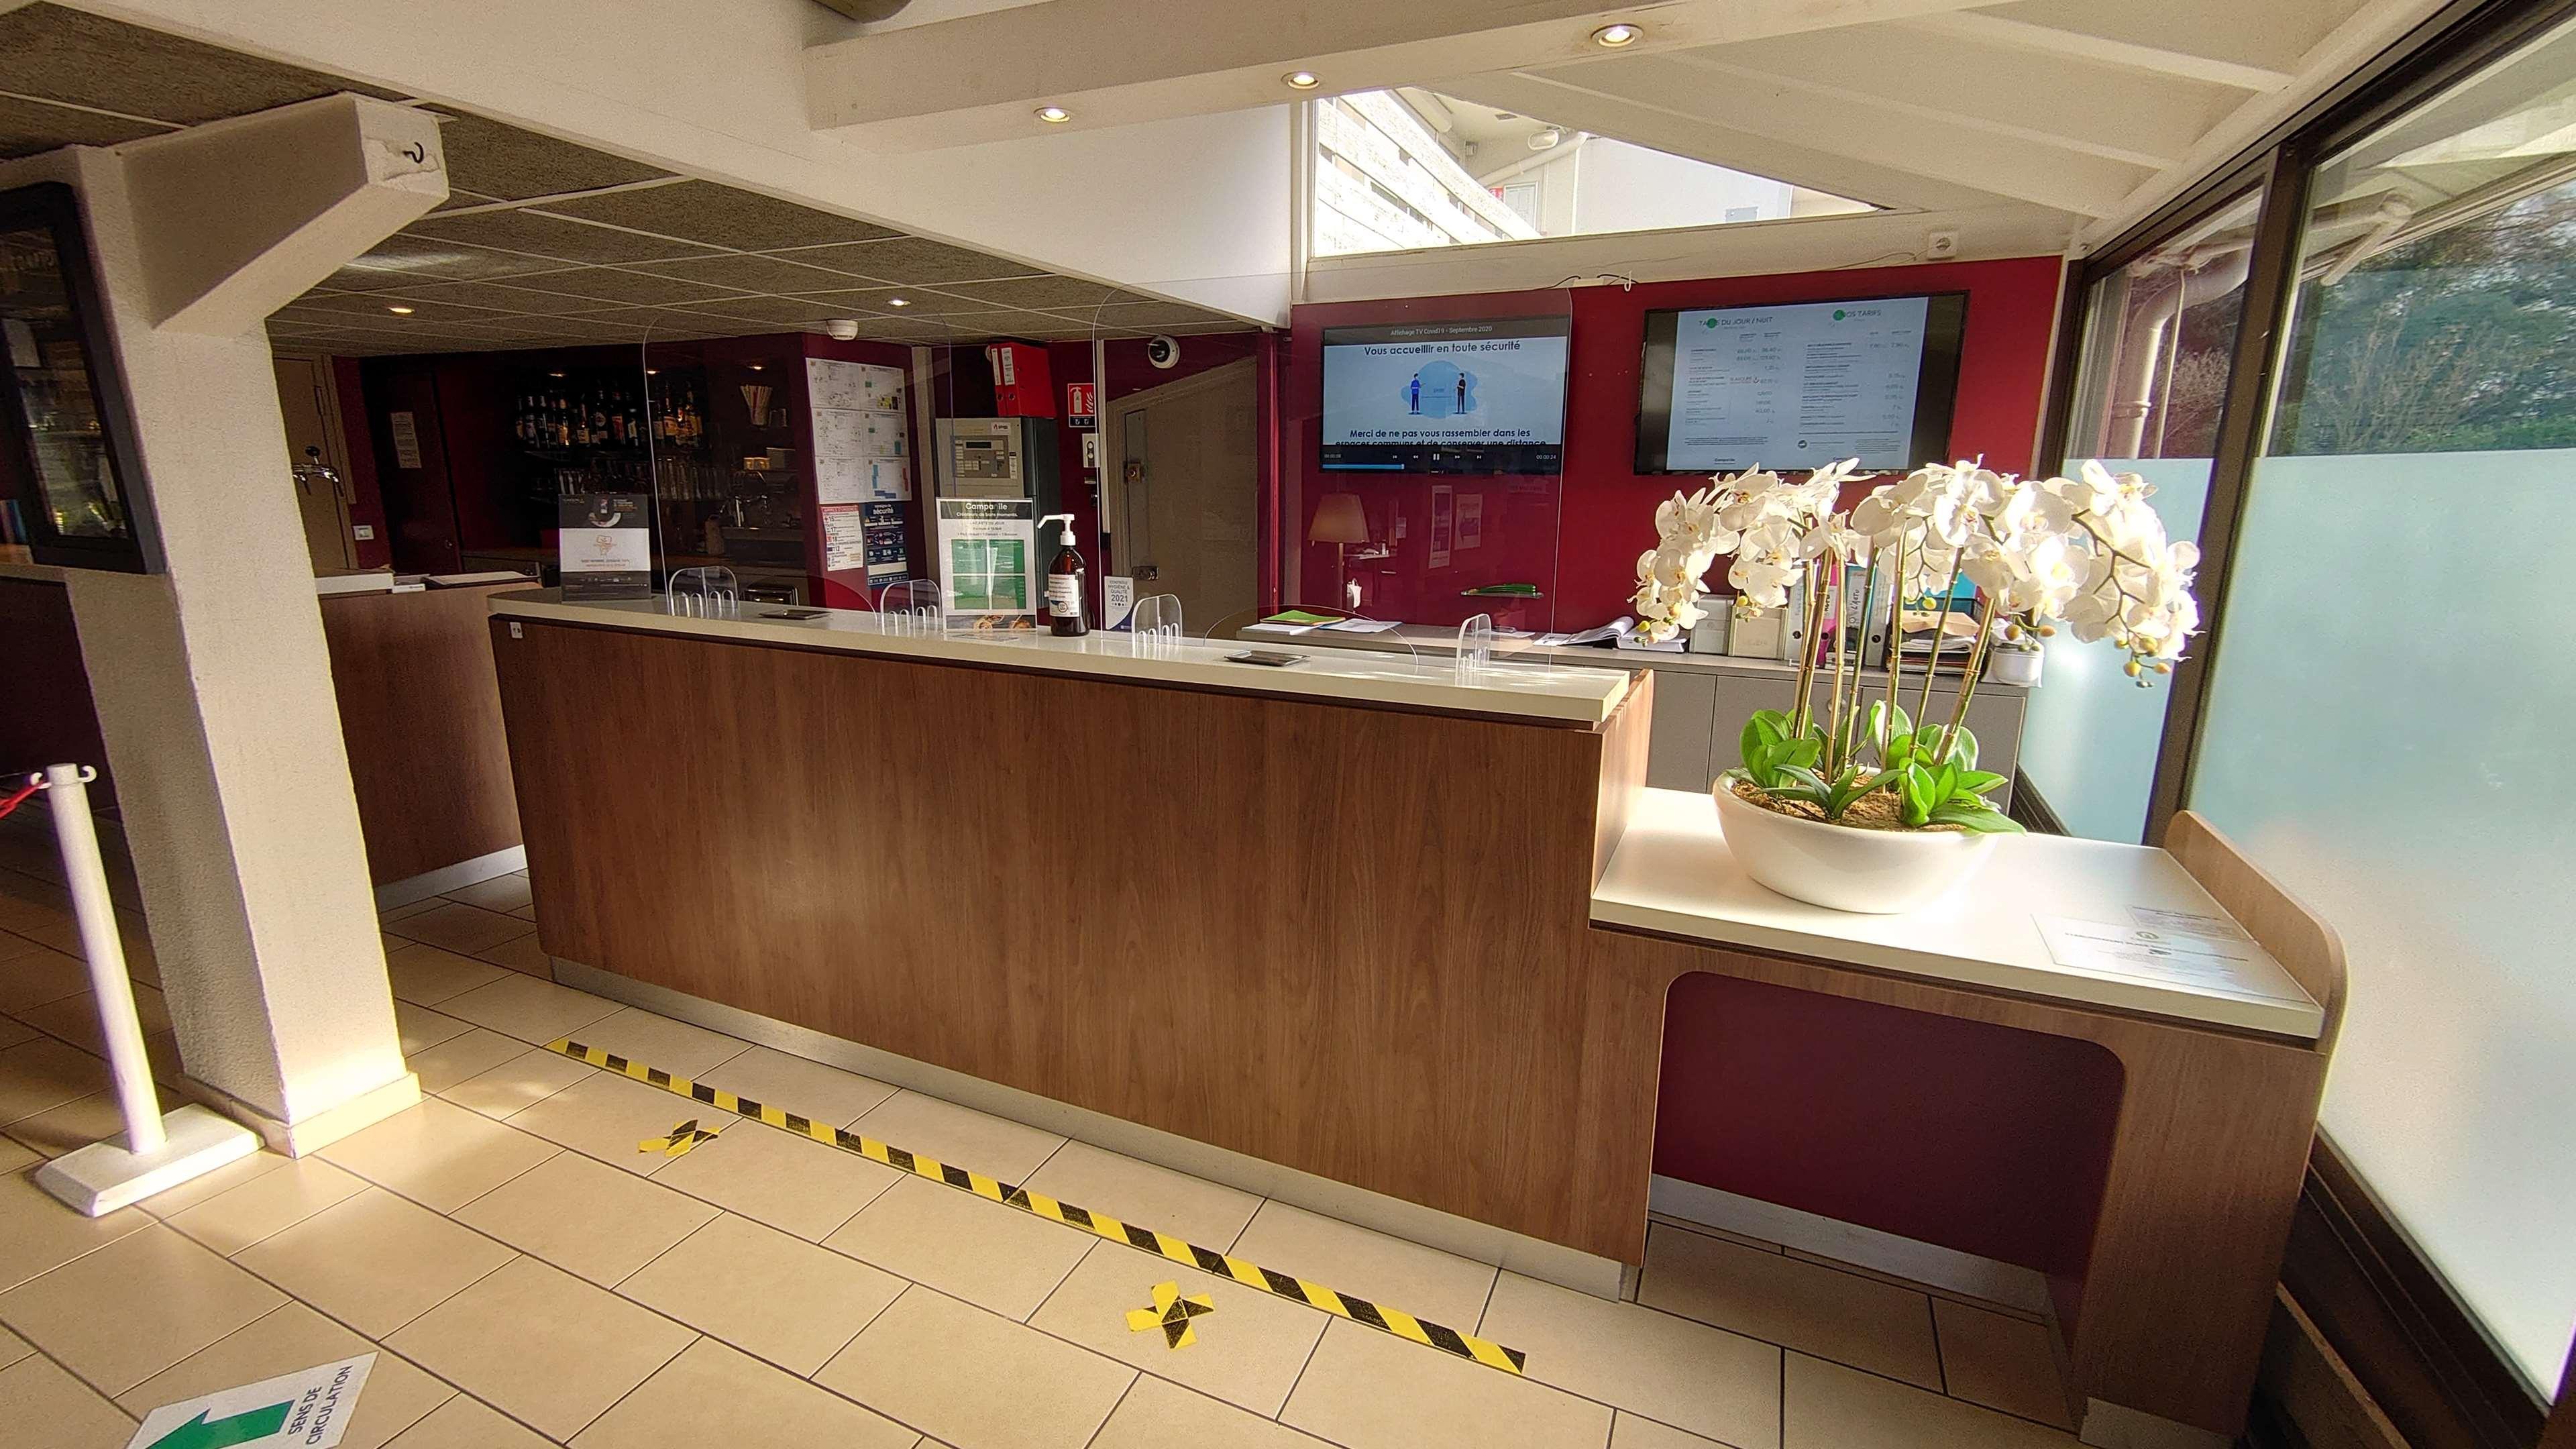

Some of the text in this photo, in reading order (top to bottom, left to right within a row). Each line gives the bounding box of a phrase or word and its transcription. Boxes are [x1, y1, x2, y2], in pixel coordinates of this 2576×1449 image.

[1699, 319, 1720, 327] TAS
[1390, 327, 1415, 336] Affichage
[1449, 326, 1478, 334] Septembre
[1364, 346, 1387, 356] Vous
[1390, 344, 1434, 355] accueillir
[1452, 342, 1478, 353] toute
[1480, 340, 1521, 352] sécurité
[1350, 429, 1373, 438] Merci
[1375, 429, 1387, 437] de
[1401, 430, 1418, 439] pas
[1442, 429, 1491, 437] rassembler
[1493, 429, 1515, 437] dans
[1517, 428, 1531, 437] les
[1111, 594, 1128, 602] 2021
[306, 1365, 354, 1445] CIRCULATION
[288, 1387, 322, 1435] SENS DE
